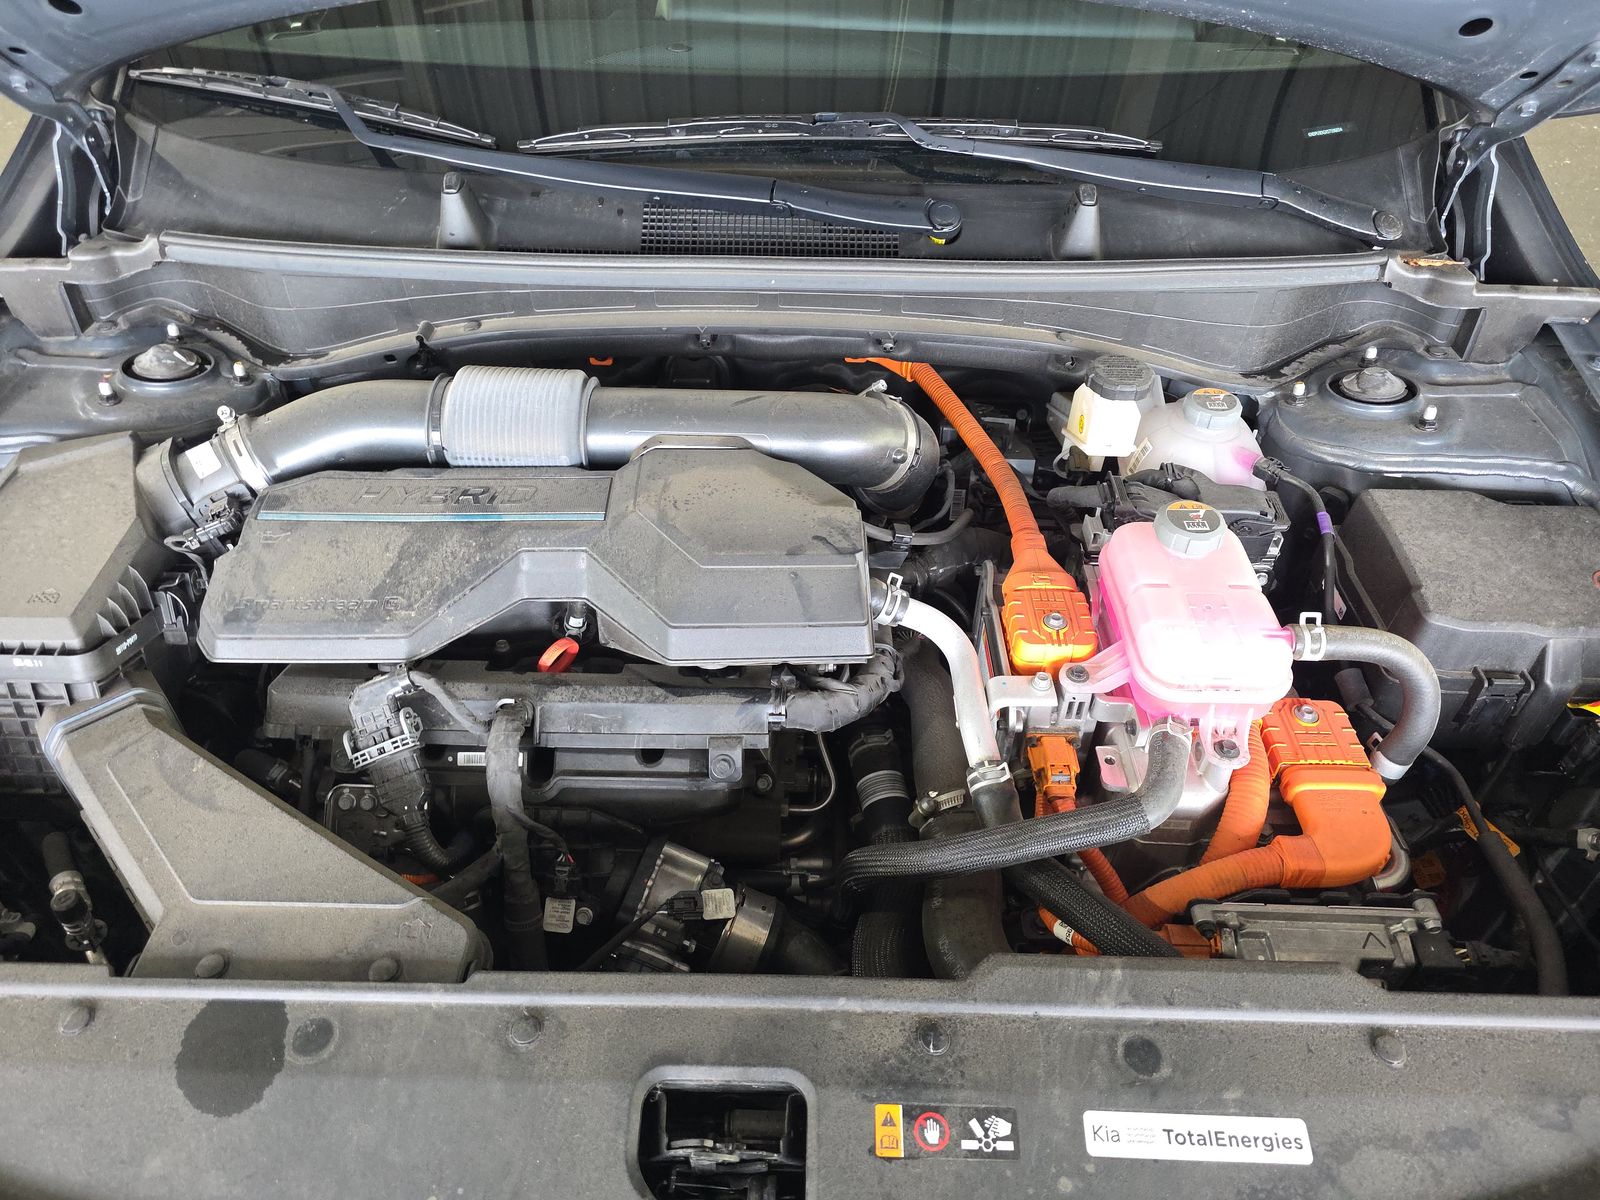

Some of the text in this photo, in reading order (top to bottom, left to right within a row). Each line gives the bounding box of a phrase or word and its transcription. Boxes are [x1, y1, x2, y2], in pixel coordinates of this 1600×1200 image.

[350, 485, 538, 505] HYBRID
[1092, 1124, 1121, 1143] Kia
[1162, 1128, 1304, 1153] TotalEnergies
